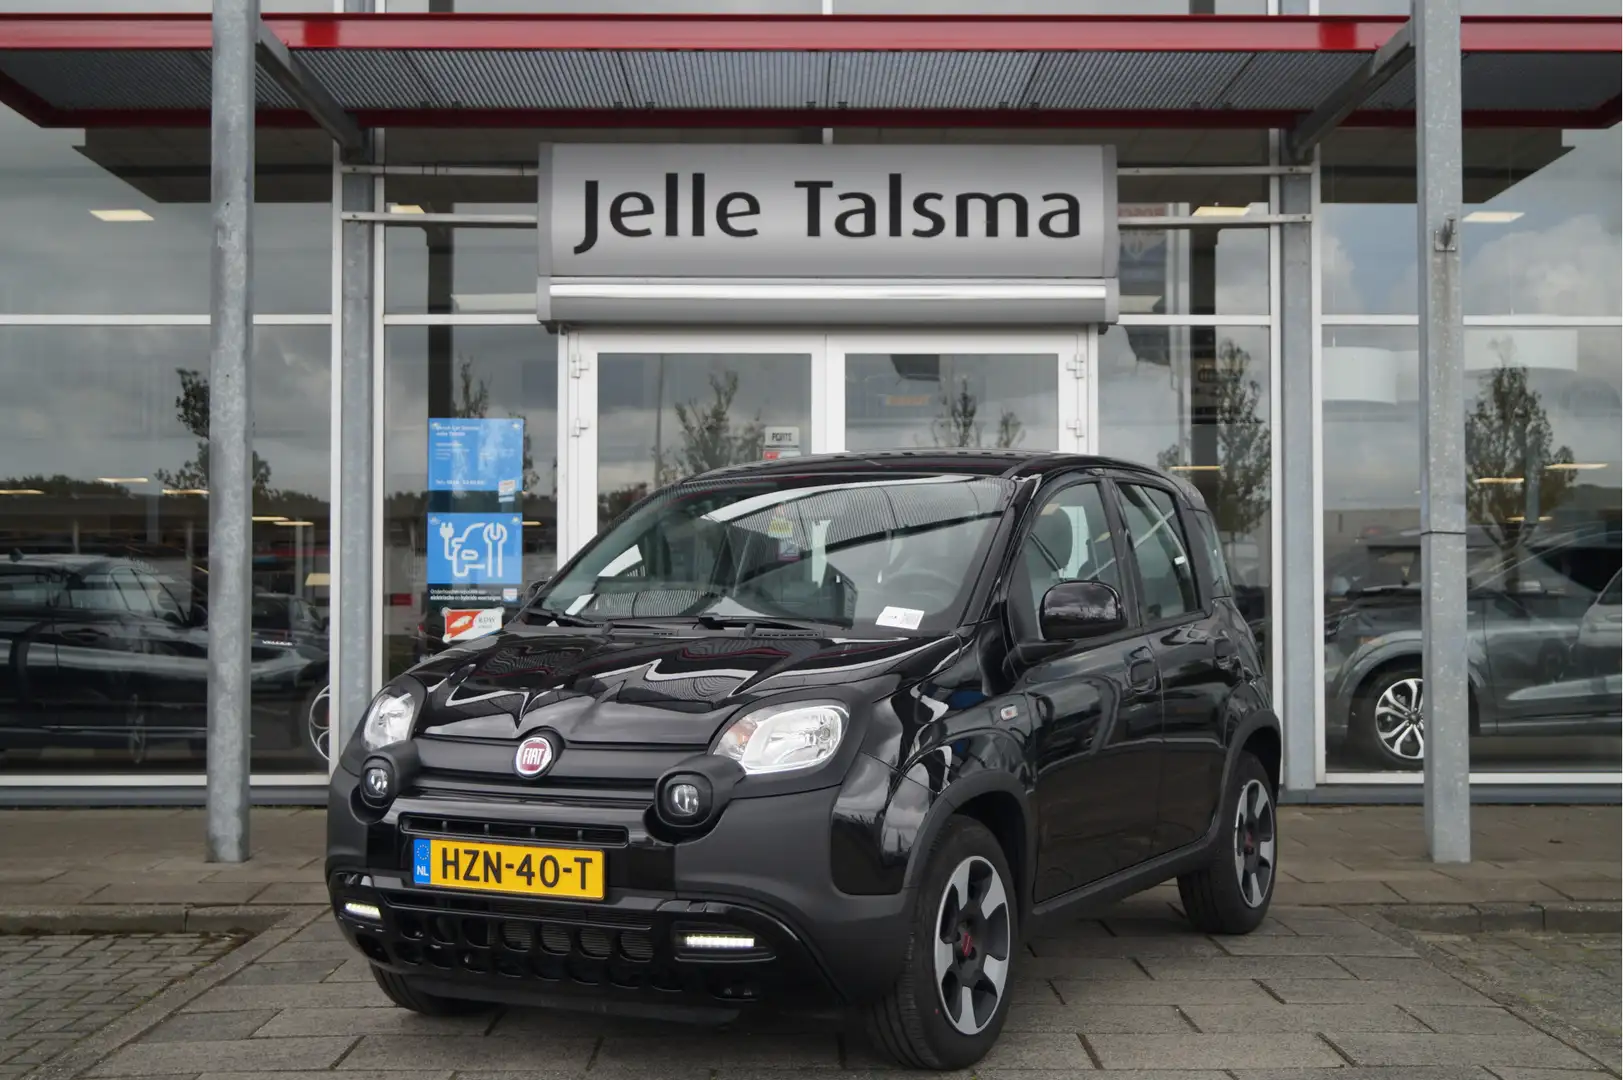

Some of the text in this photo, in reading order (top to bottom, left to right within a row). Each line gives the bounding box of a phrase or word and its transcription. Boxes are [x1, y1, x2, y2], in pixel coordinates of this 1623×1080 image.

[574, 173, 1081, 255] Jelle Talsma
[522, 747, 546, 765] FIAT
[416, 865, 429, 877] NL
[441, 847, 593, 891] HZN-40-T
